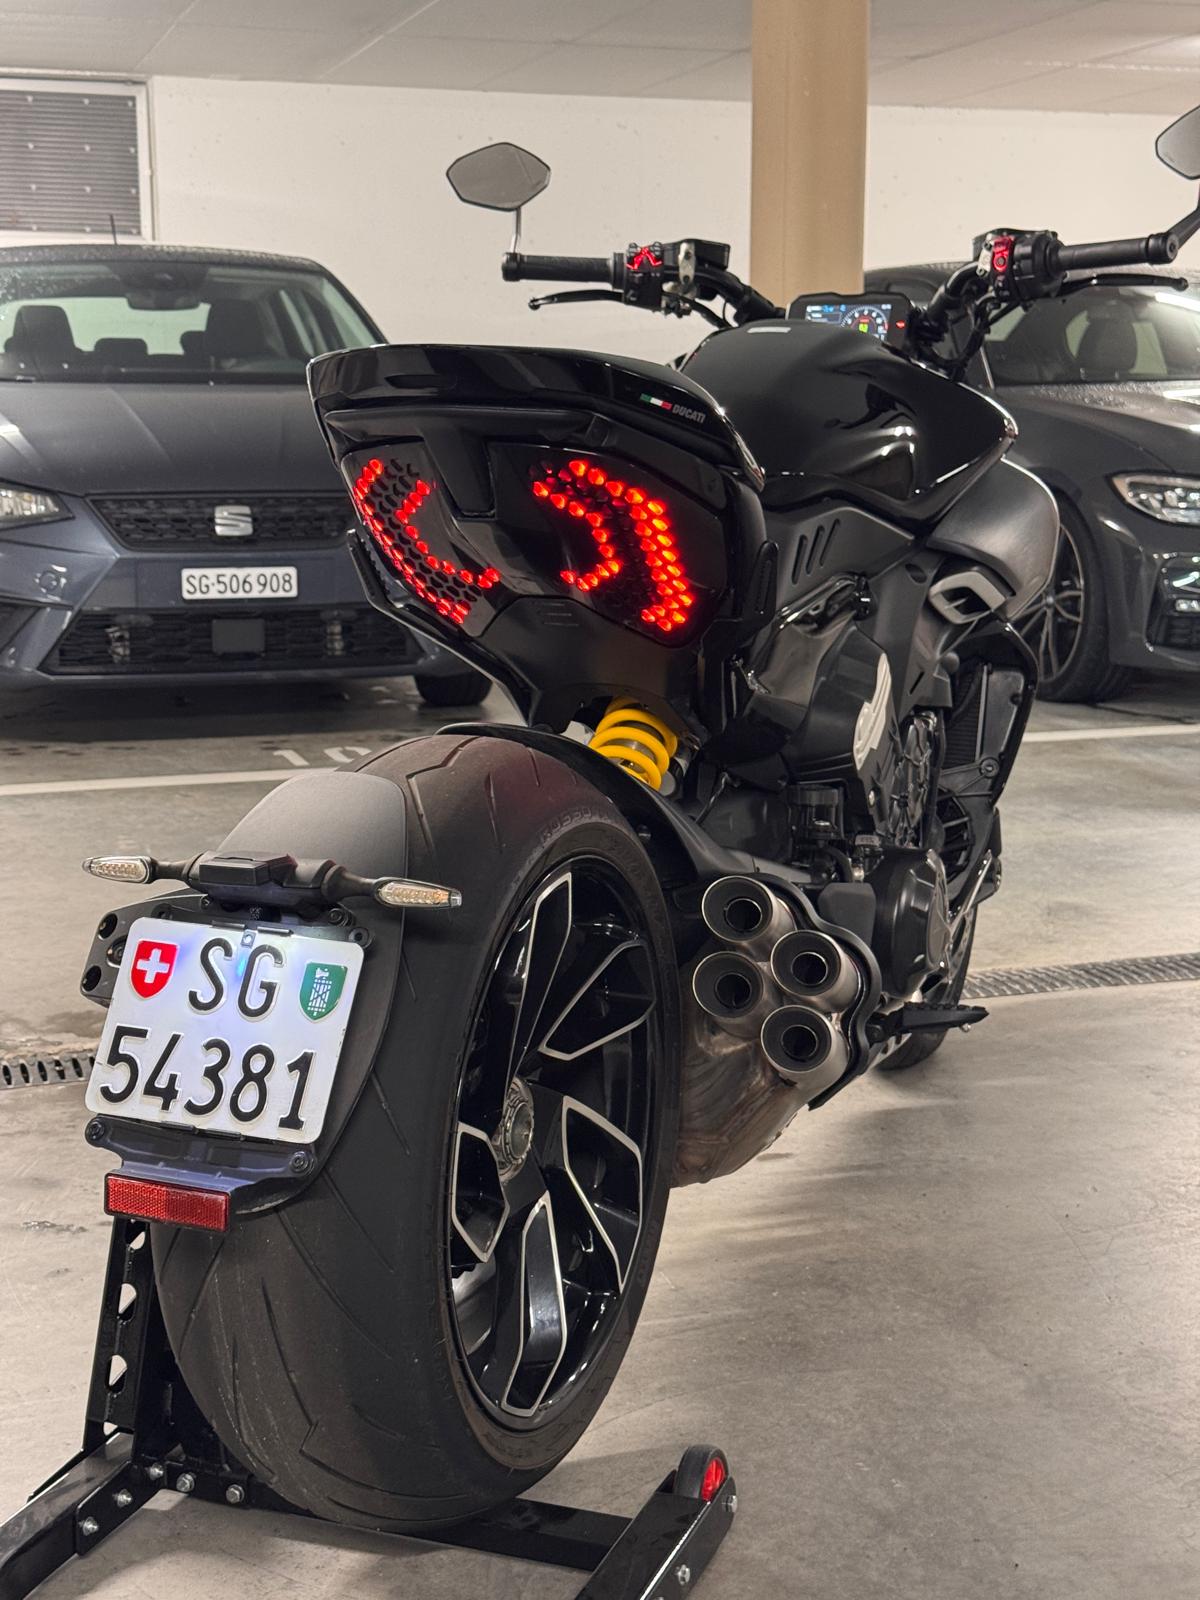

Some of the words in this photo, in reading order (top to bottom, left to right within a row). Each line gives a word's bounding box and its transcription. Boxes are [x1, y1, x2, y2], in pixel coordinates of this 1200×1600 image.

[672, 403, 706, 423] DUCATI
[188, 937, 284, 1018] SG
[100, 1024, 315, 1130] 54381
